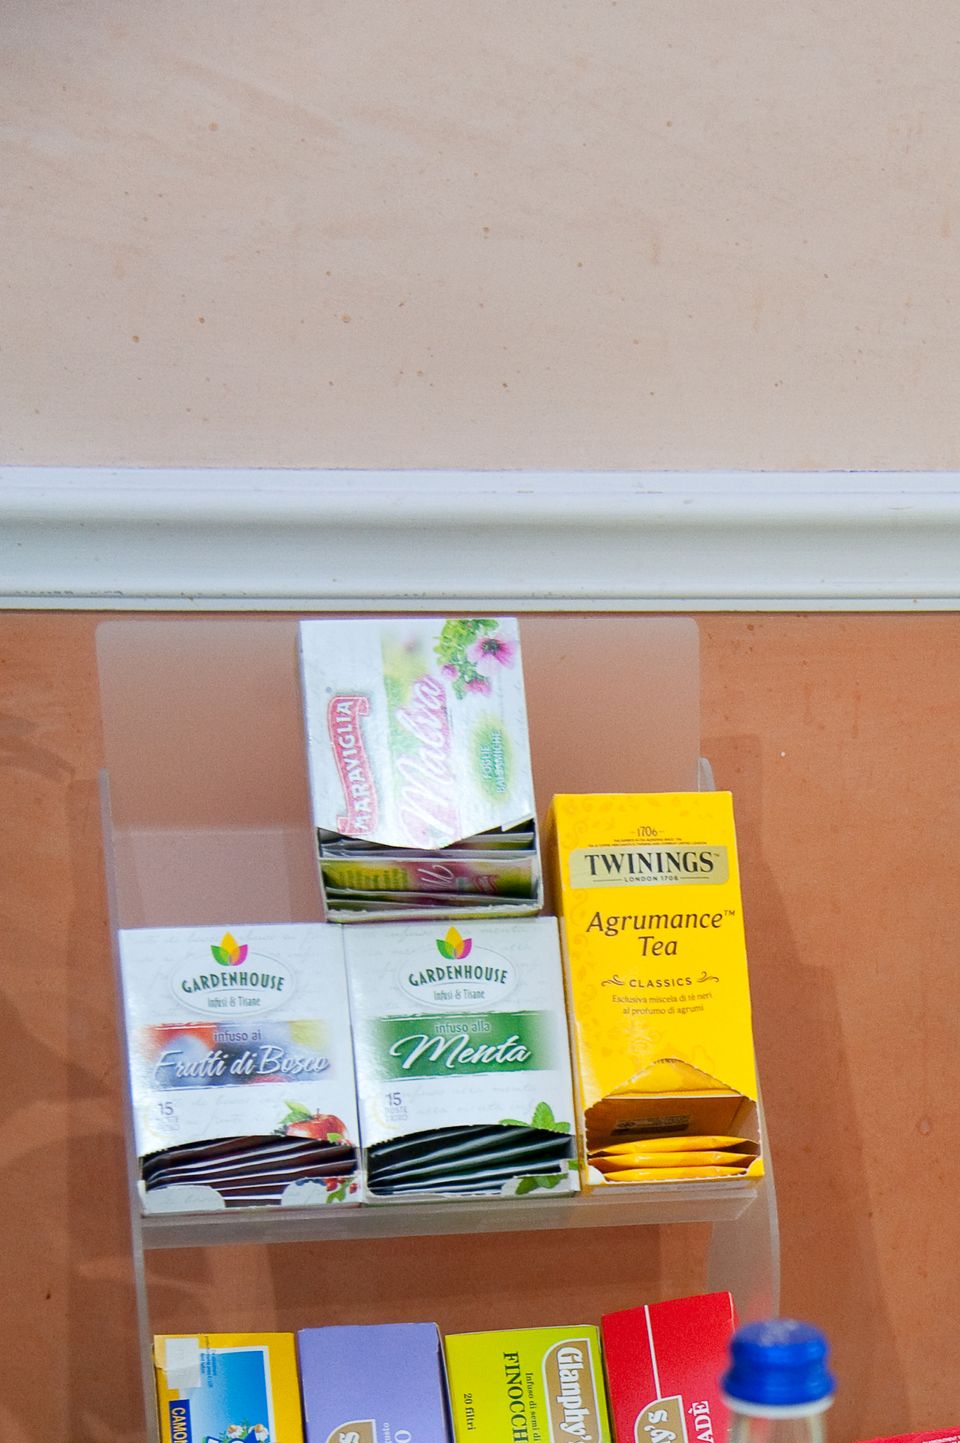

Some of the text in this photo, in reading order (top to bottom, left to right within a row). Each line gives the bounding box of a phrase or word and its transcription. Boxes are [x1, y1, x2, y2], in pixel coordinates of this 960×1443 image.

[335, 700, 370, 833] MARAVIGLIA
[584, 851, 714, 876] TWININGS
[638, 936, 678, 957] Tea
[181, 971, 285, 993] GARDENHOUSE
[408, 965, 508, 986] GARDENHOUSE
[629, 976, 693, 988] CLASSICS
[214, 1031, 249, 1042] infuso
[436, 1020, 490, 1033] infuso alla
[389, 1033, 532, 1070] Menta
[155, 1045, 331, 1082] Frutti di Bosco
[158, 1101, 174, 1116] 15
[385, 1091, 402, 1106] 15
[464, 1393, 476, 1431] 20 filtri
[525, 1372, 535, 1399] Infuso
[530, 1411, 540, 1431] semi
